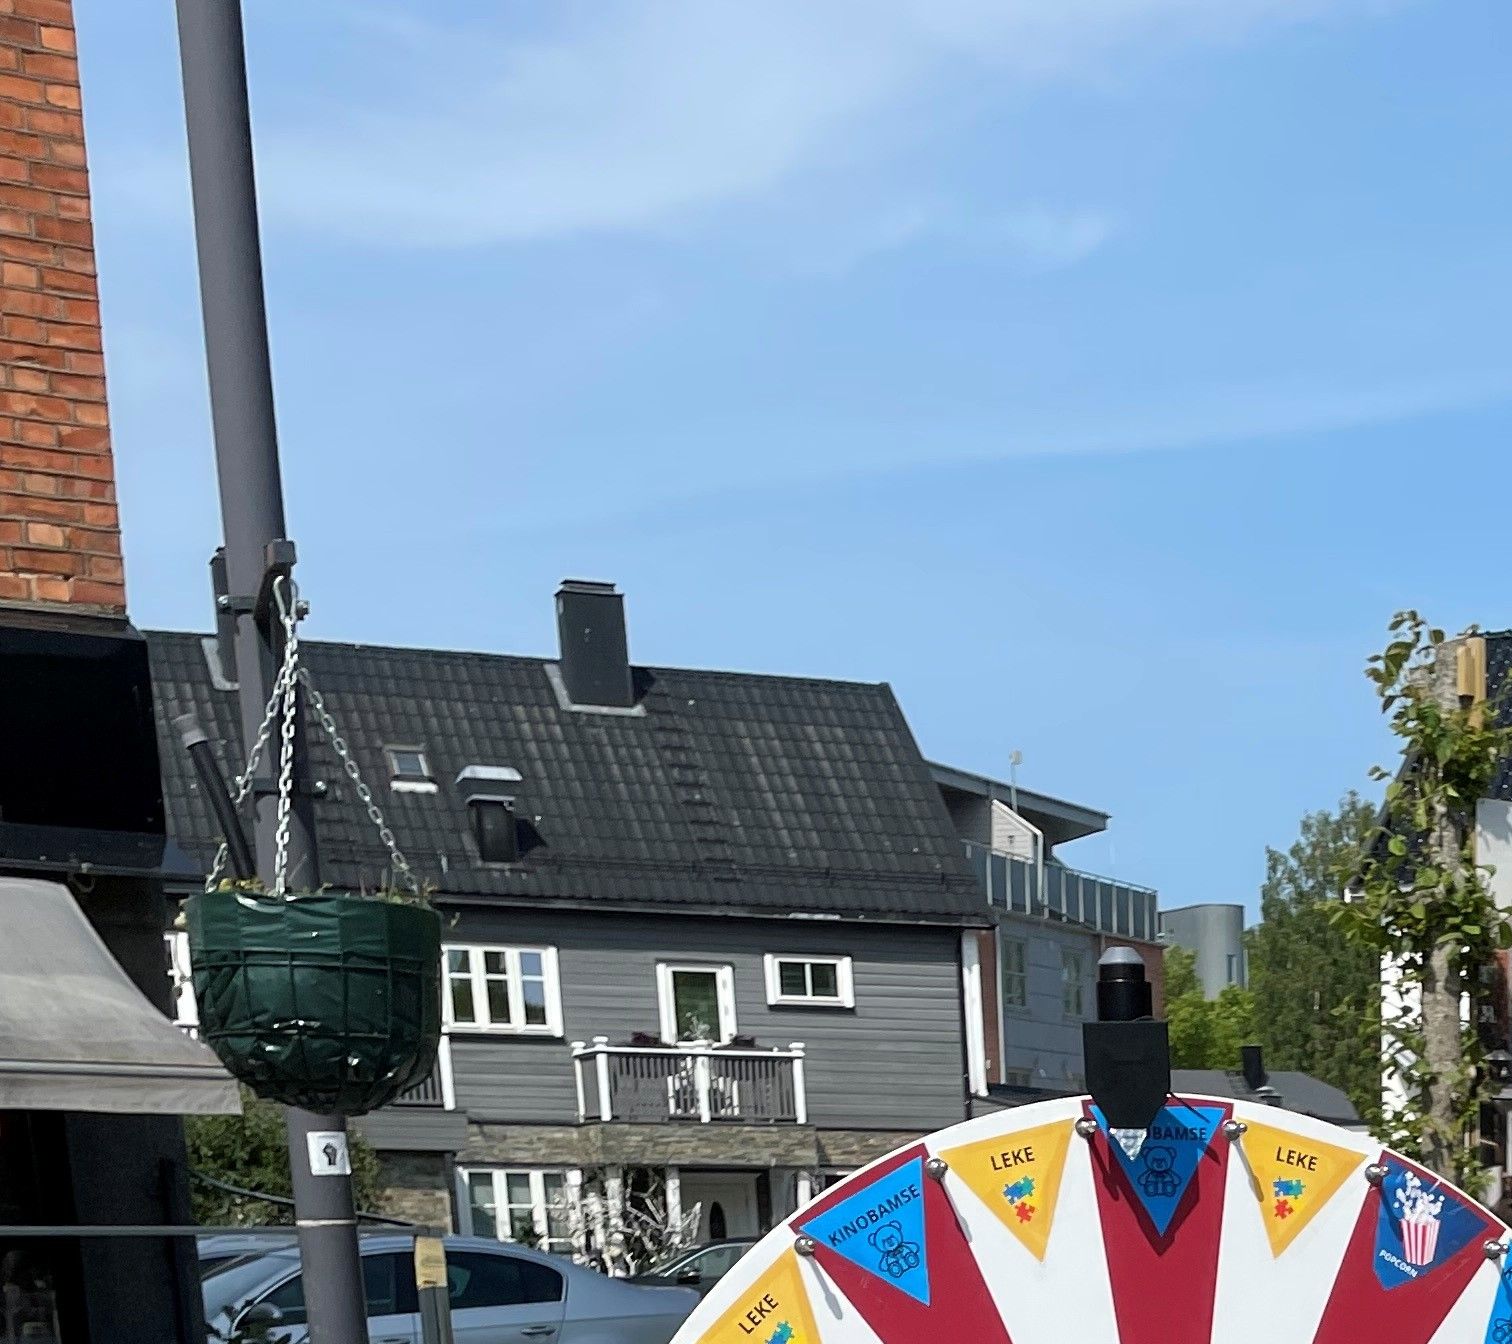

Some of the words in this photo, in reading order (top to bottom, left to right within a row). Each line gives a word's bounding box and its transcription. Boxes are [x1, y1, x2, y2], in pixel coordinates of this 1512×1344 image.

[1152, 1126, 1207, 1142] BAMSE
[990, 1146, 1035, 1171] LEKE
[1276, 1146, 1318, 1172] LEKE
[827, 1183, 921, 1247] KINOBAMSE
[1379, 1248, 1419, 1279] POPCORN
[738, 1293, 780, 1336] LEKE
